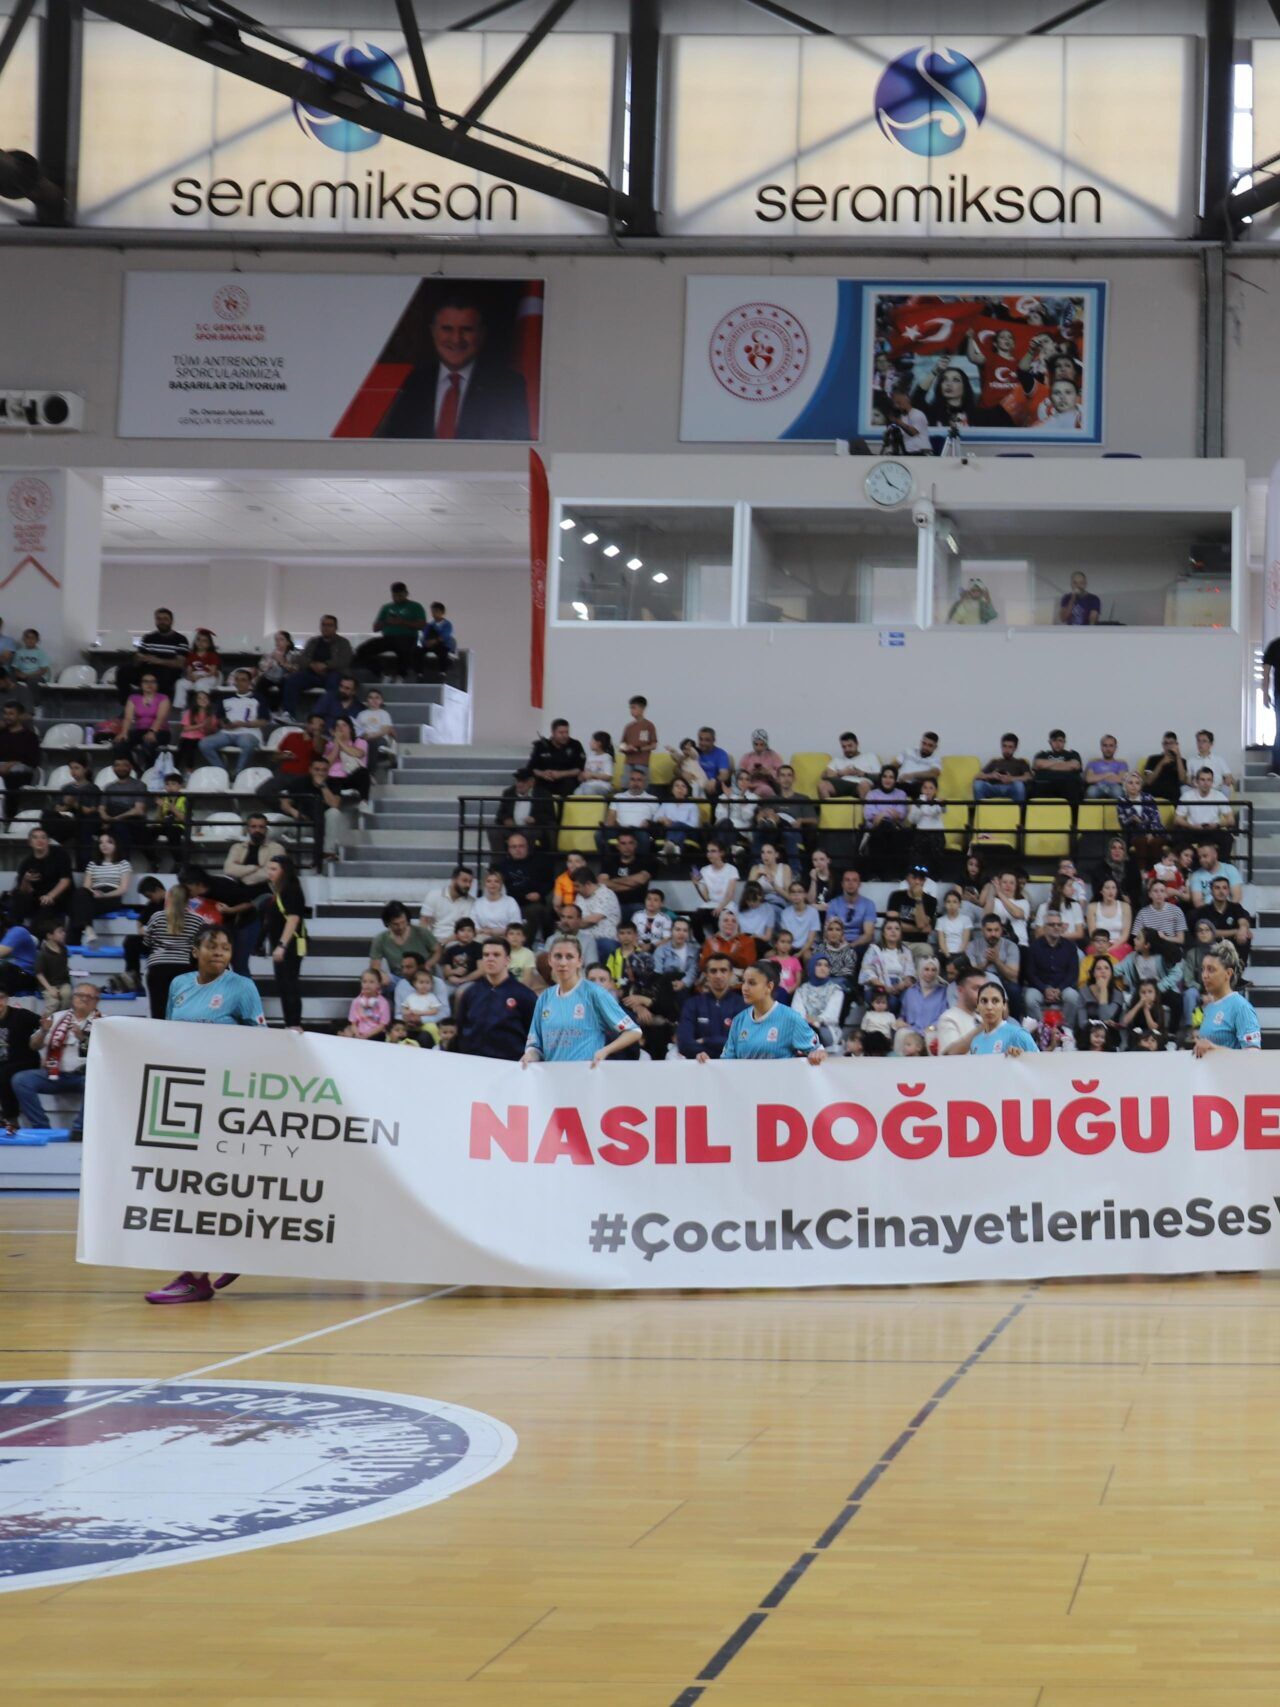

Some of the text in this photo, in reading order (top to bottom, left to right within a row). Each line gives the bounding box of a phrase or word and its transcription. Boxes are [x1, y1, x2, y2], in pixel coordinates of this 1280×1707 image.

[171, 171, 518, 221] seramiksan
[756, 175, 1101, 223] seramiksan
[173, 354, 200, 366] TÜM
[269, 357, 285, 367] VE
[175, 367, 282, 380] SPORCULARIMIZA
[168, 381, 227, 392] BAŞARILAR
[217, 1106, 400, 1147] GARDEN
[470, 1102, 732, 1166] NASIL
[756, 1079, 1170, 1163] DOĞDUĞU
[216, 1140, 299, 1158] CITY
[131, 1165, 324, 1203] TURGUTLU
[122, 1199, 336, 1243] BELEDİYESİ
